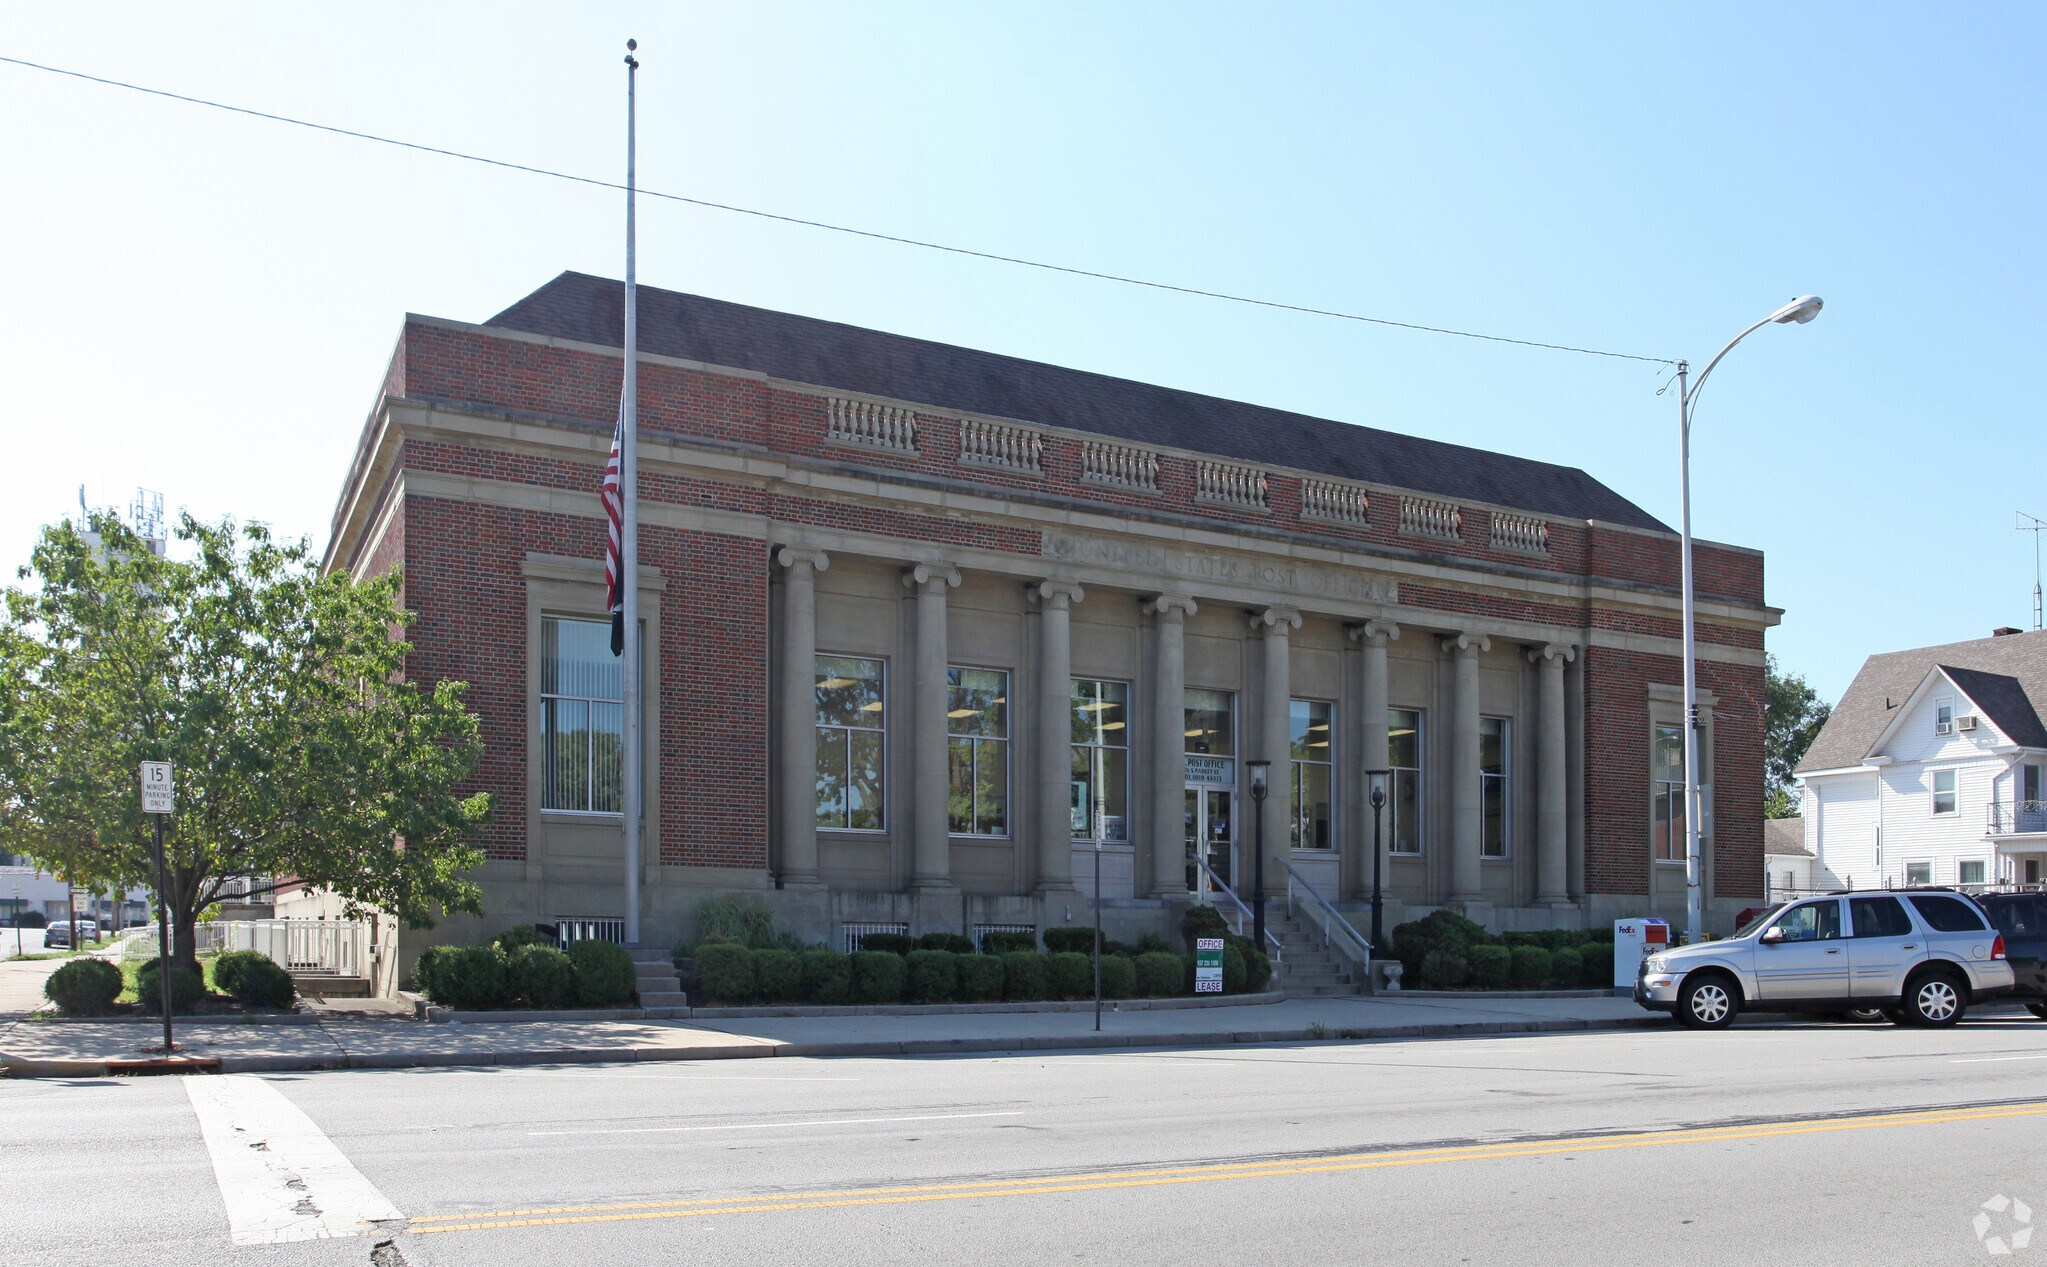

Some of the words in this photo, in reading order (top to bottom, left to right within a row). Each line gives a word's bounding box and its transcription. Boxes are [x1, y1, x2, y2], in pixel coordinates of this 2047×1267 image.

[1174, 552, 1239, 578] STATES
[1251, 562, 1297, 586] POST
[1310, 573, 1372, 597] OFFICE
[1188, 759, 1202, 767] POST
[1203, 760, 1225, 769] OFFICE
[150, 767, 163, 781] 15
[146, 783, 168, 791] MINUTE
[145, 791, 171, 799] PARKING
[1618, 926, 1636, 934] FedEx
[1198, 940, 1223, 948] OFFICE
[1197, 983, 1220, 991] LEASE
